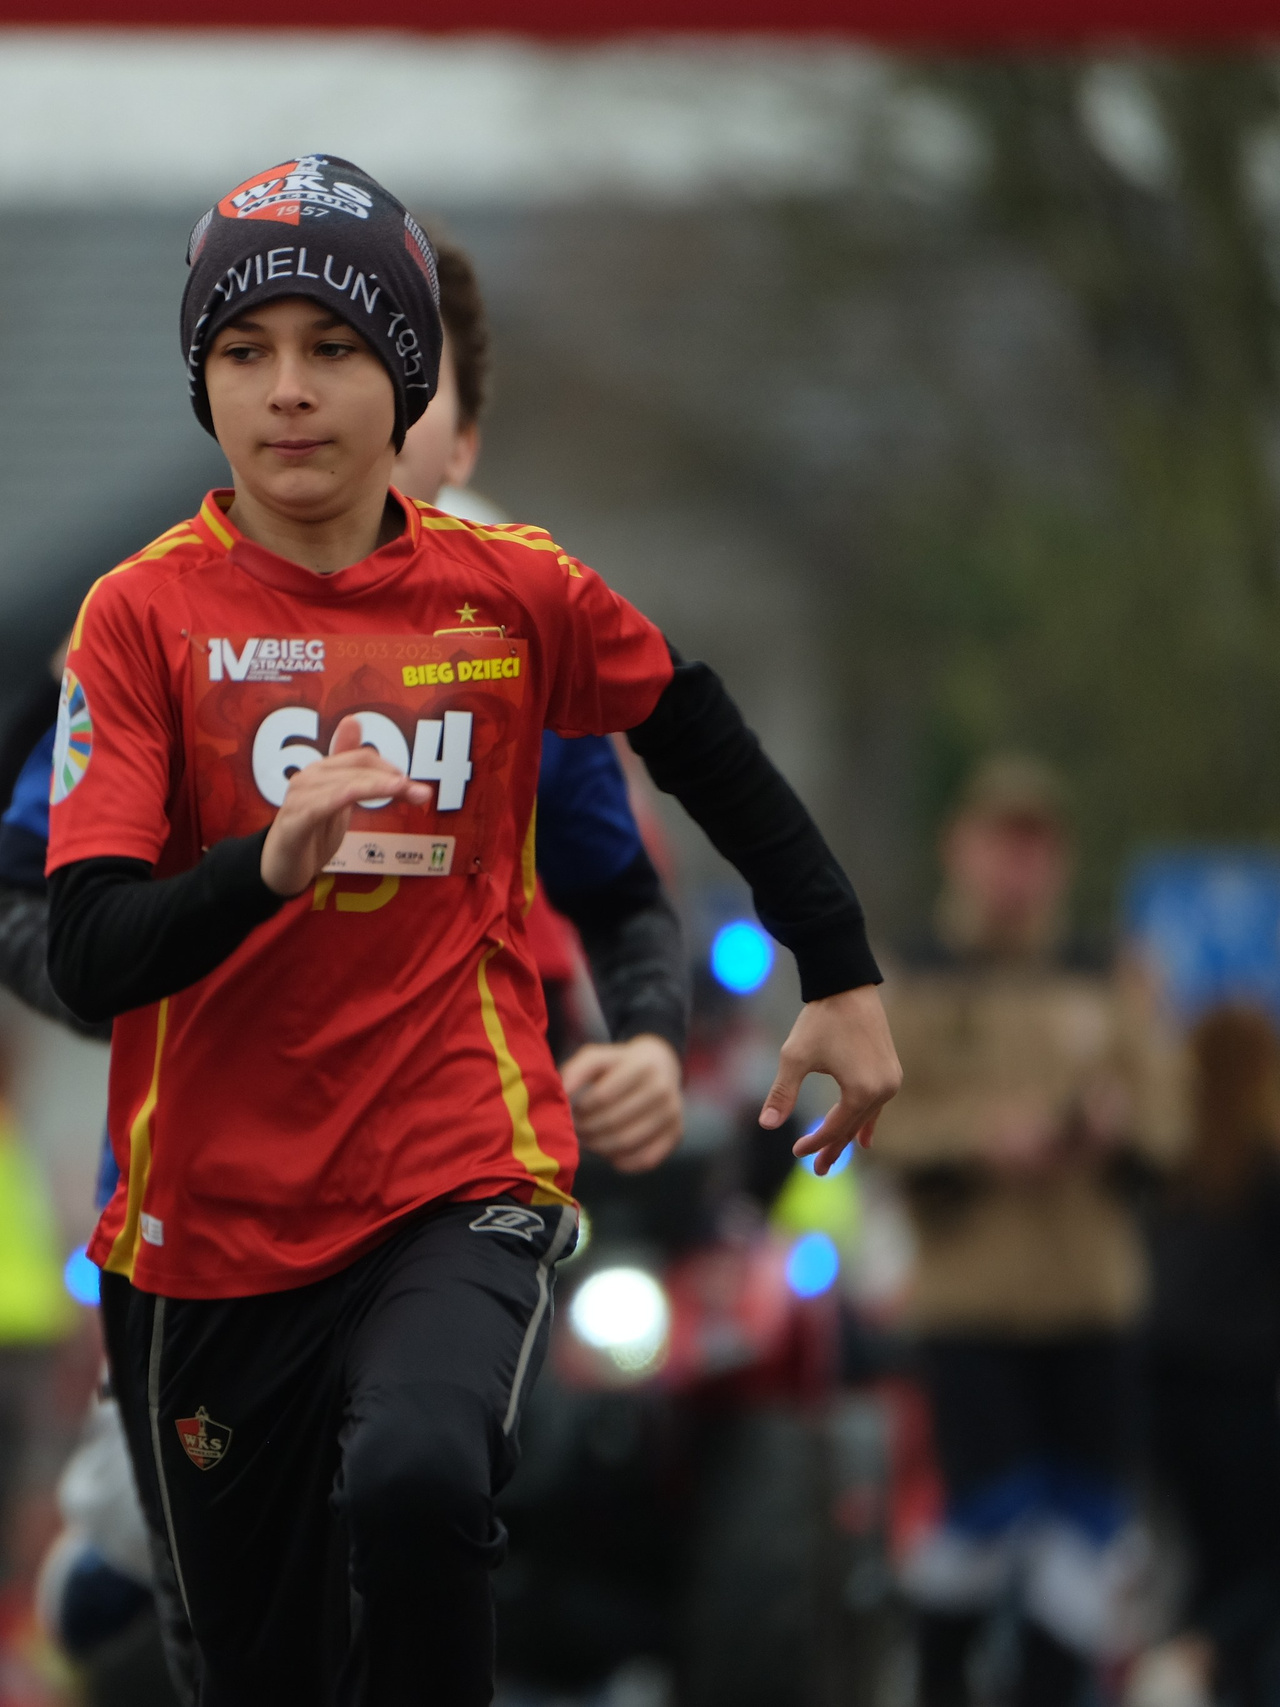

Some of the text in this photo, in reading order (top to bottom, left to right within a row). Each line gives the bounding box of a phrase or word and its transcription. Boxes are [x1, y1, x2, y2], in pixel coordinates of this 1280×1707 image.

[231, 175, 373, 208] WKS
[276, 205, 330, 217] 1957
[207, 637, 326, 682] IV BIEG
[402, 657, 520, 687] BIEG DZIECI
[183, 1433, 222, 1450] WKS
